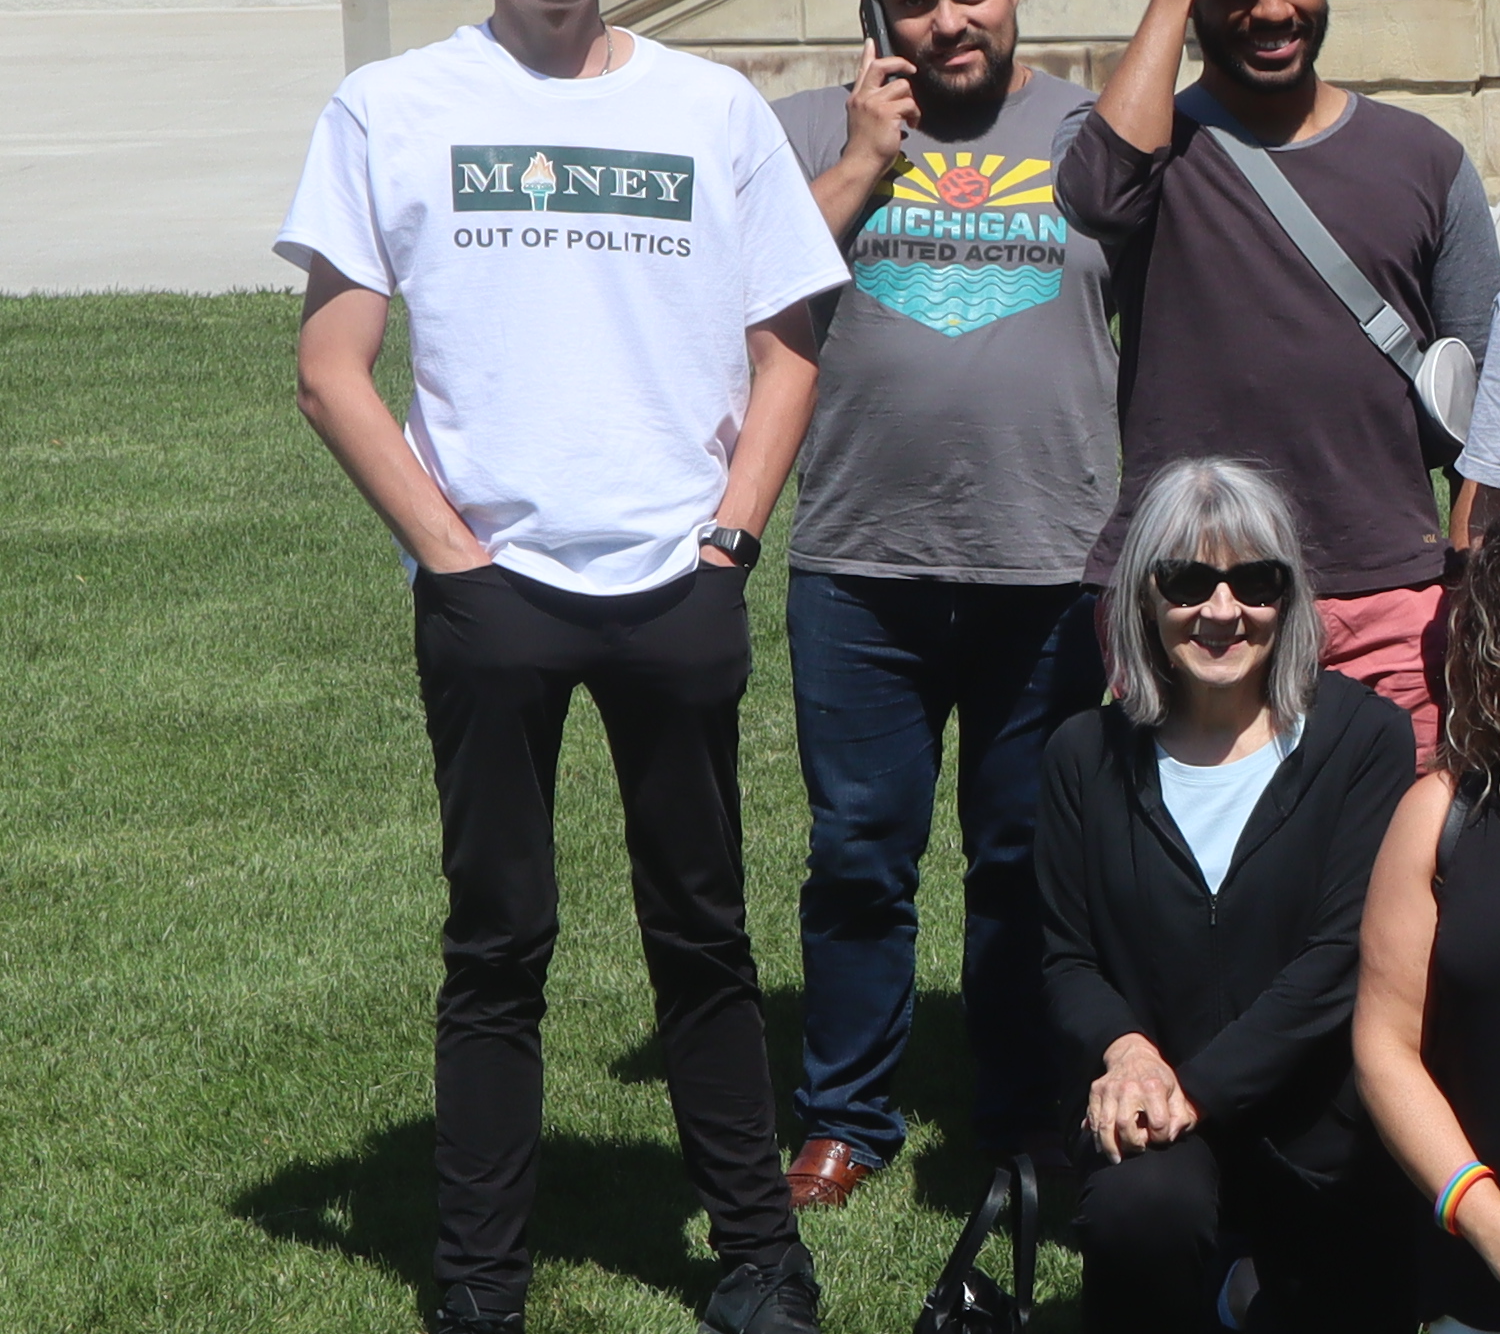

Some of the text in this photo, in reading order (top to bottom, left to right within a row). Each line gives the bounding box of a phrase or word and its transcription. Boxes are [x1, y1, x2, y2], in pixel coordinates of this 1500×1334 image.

[859, 206, 1068, 244] MICHIGAN
[454, 228, 691, 258] OUT OF POLITICS
[852, 238, 1065, 266] UNITED ACTION
